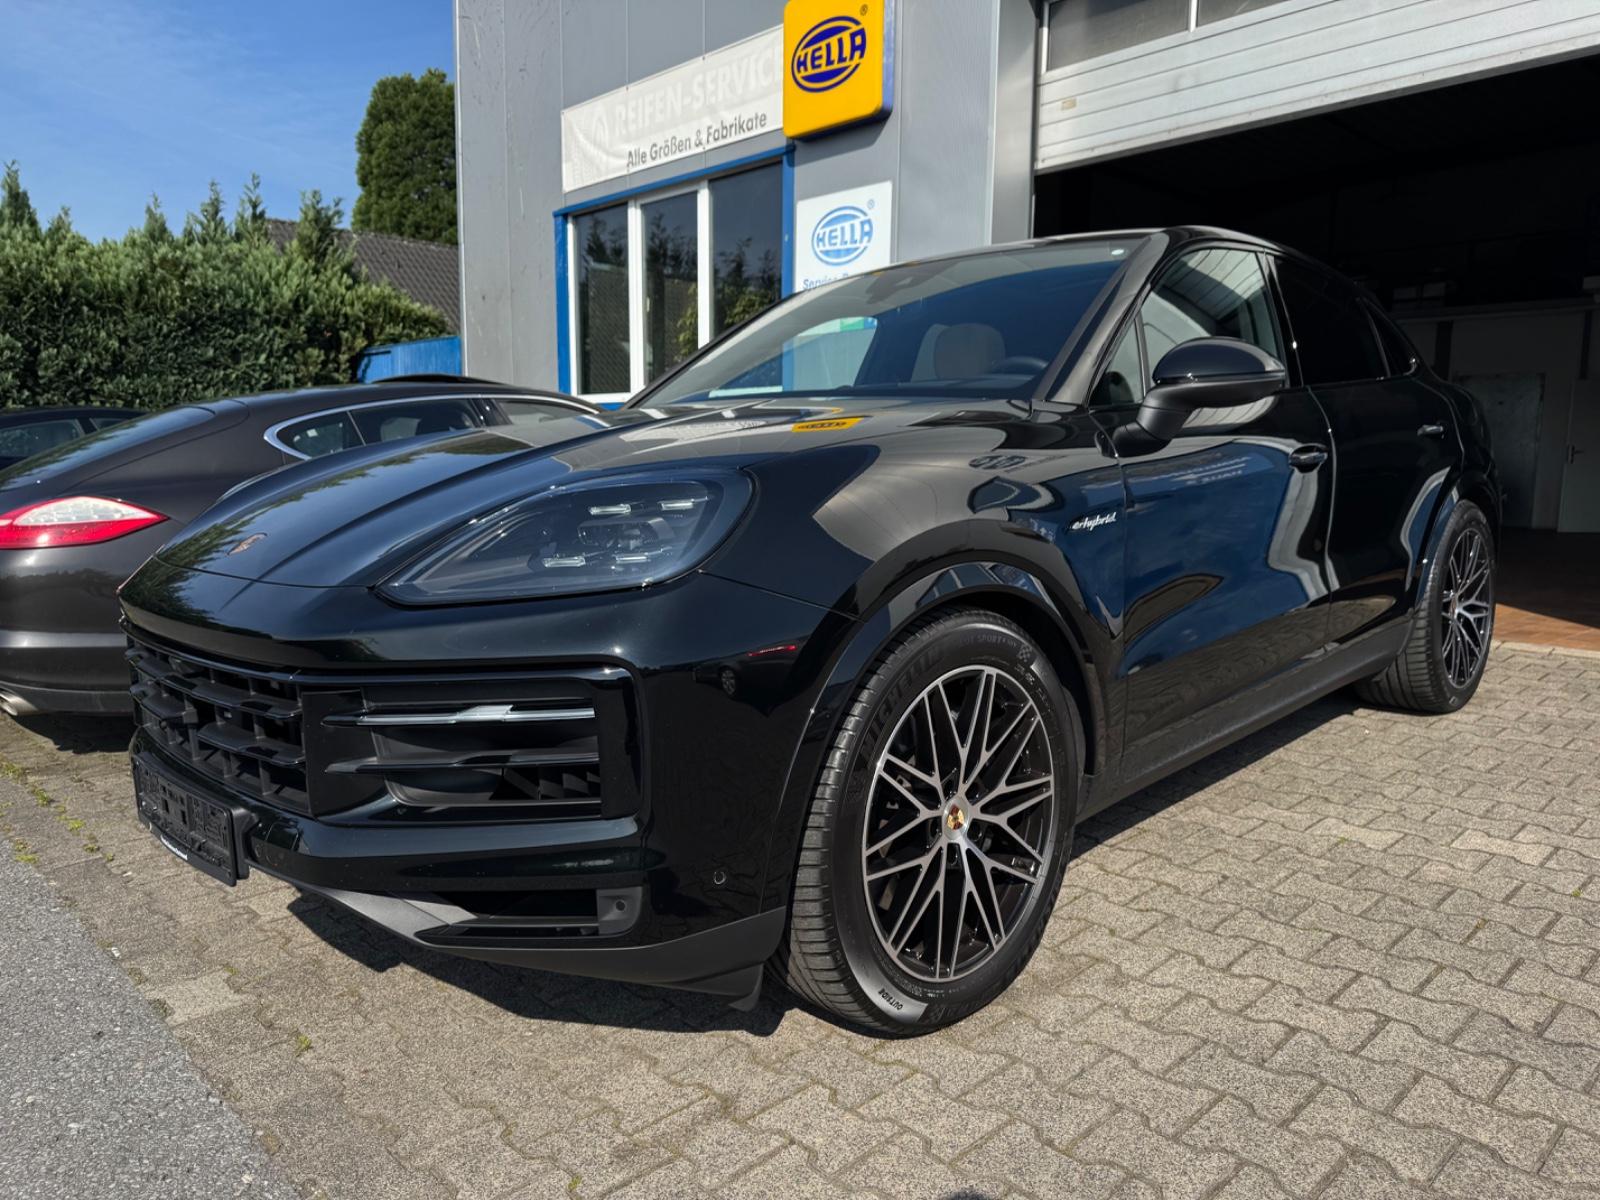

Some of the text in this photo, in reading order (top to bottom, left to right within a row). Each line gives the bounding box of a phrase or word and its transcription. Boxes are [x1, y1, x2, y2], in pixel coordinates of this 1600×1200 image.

[796, 28, 866, 74] HELLA
[627, 112, 767, 168] Alle Größen & Fabrikate
[816, 218, 873, 249] HELLA
